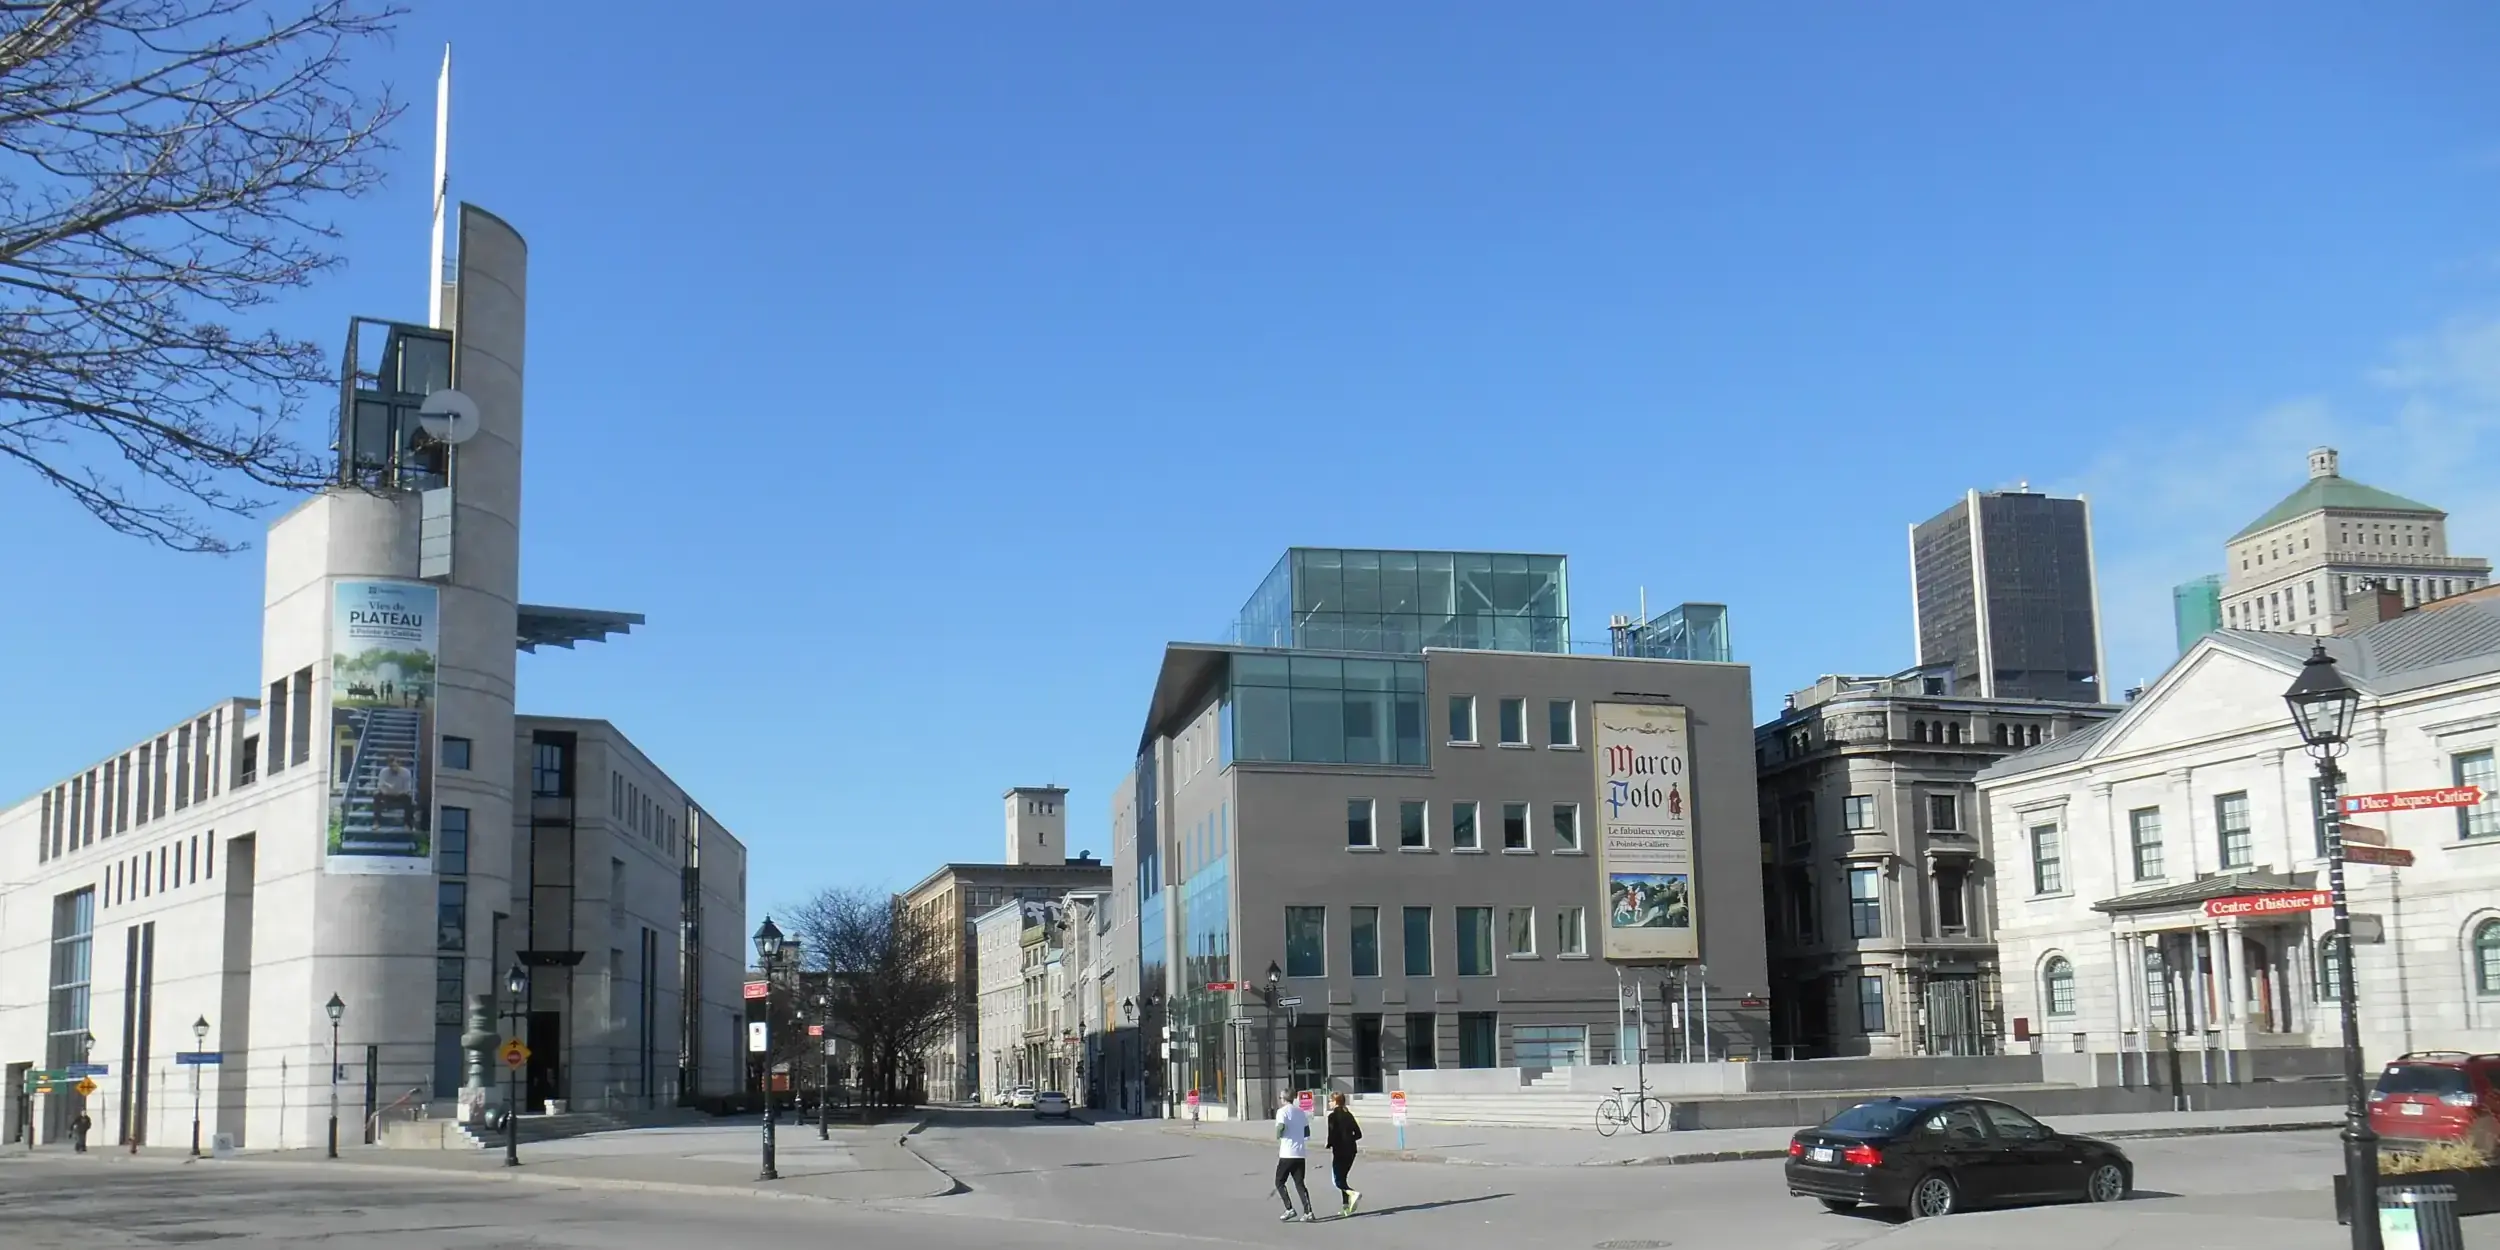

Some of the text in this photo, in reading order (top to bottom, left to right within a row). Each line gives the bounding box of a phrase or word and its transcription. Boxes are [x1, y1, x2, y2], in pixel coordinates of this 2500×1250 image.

[369, 602, 390, 611] Vies
[350, 611, 422, 627] PLATEAU
[1604, 745, 1682, 778] Marco
[1605, 778, 1662, 819] Polo
[2360, 790, 2473, 810] Place Jacques-Cartier
[1608, 827, 1618, 835] Le
[1620, 827, 1655, 835] fabuleux
[2211, 897, 2310, 914] Centre d'histoire
